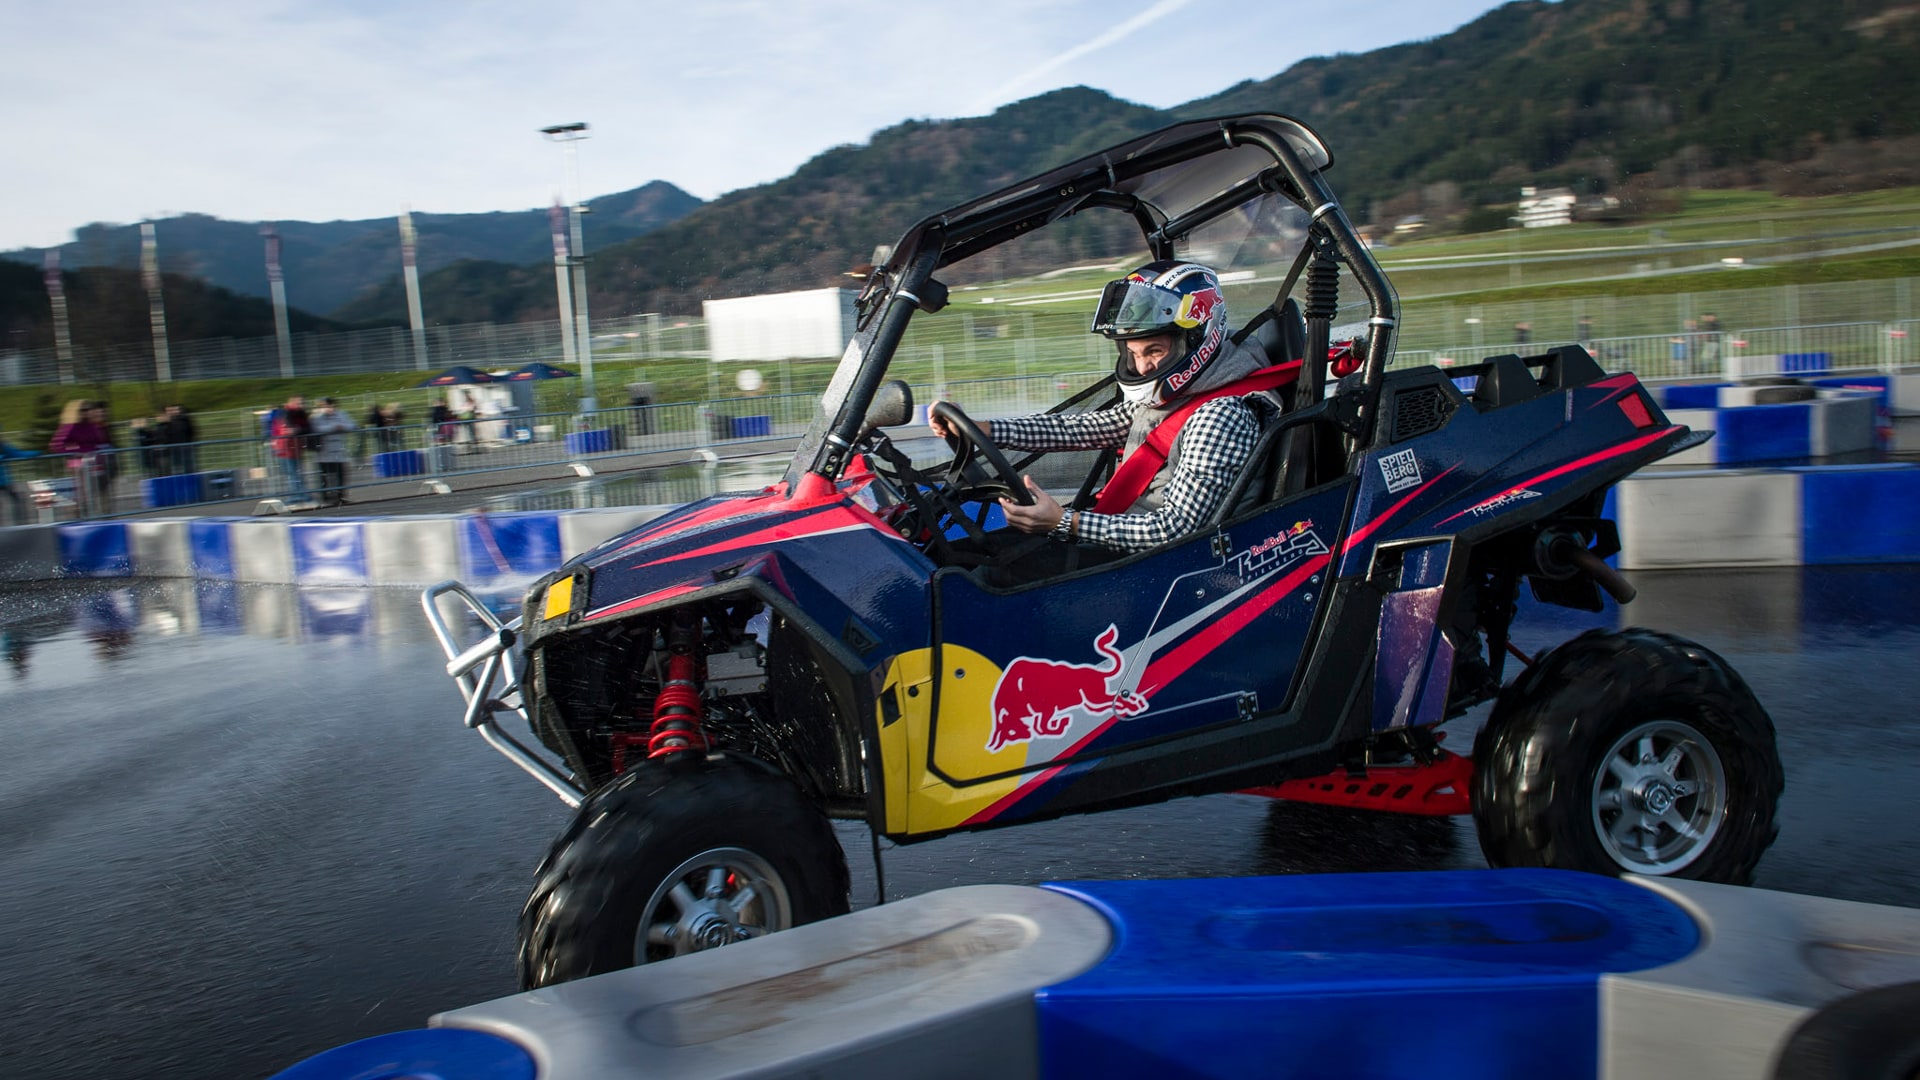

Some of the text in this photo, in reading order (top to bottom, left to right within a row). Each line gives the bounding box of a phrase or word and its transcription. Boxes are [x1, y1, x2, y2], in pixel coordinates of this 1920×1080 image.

[1166, 358, 1201, 392] Red
[1199, 327, 1222, 363] Bull
[1382, 451, 1414, 471] SPIEL
[1385, 463, 1415, 482] BERG
